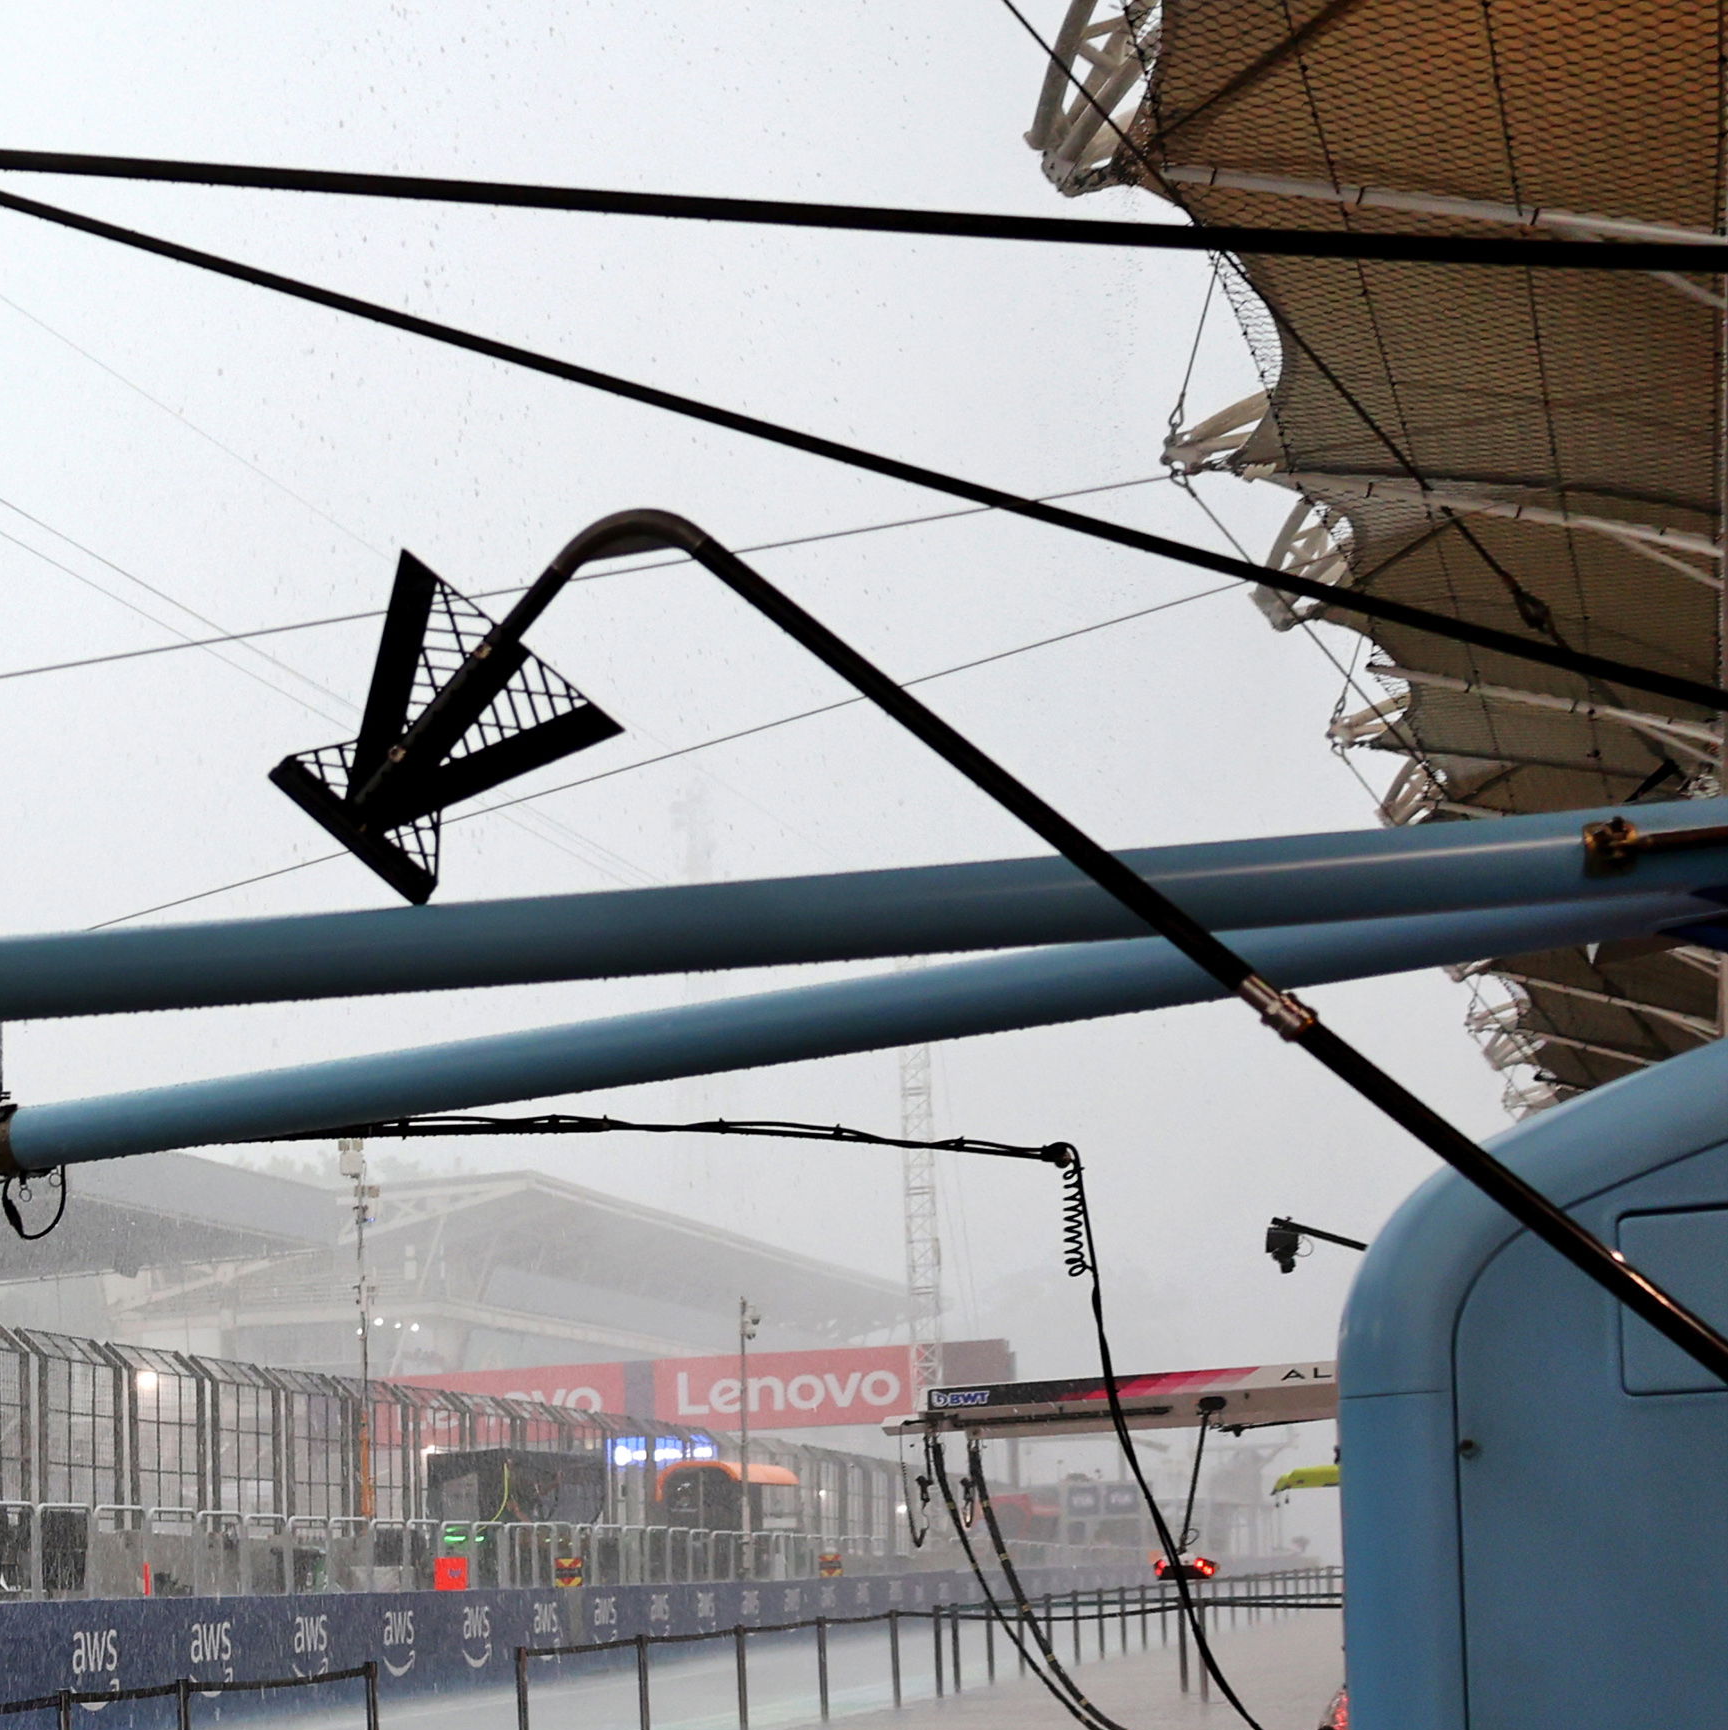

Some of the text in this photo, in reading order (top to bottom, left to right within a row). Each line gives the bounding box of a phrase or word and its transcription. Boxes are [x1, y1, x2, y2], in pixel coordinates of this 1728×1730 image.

[677, 1370, 901, 1416] Lenovo
[949, 1391, 990, 1405] BWT
[190, 1620, 233, 1665] aws
[293, 1613, 328, 1654] aws
[383, 1608, 415, 1647] aws
[463, 1605, 490, 1640] aws
[72, 1628, 118, 1675] aws
